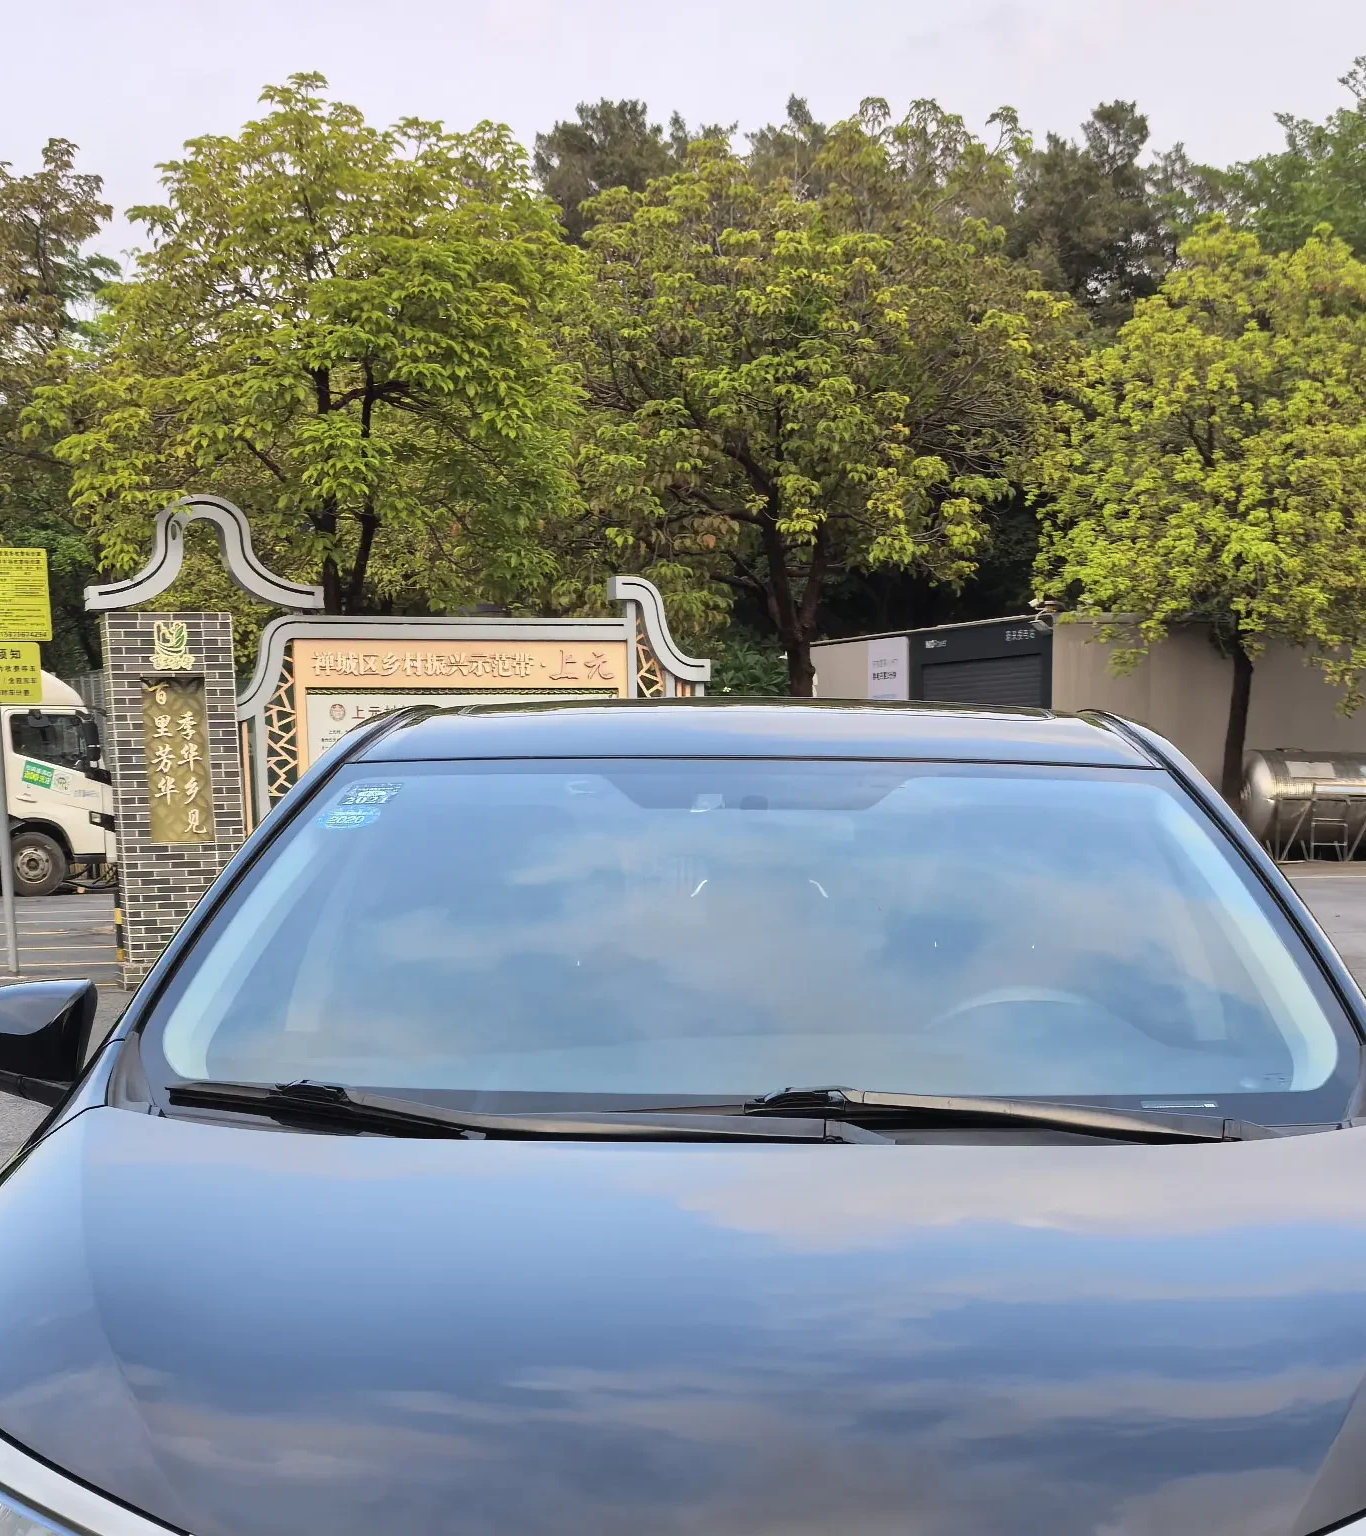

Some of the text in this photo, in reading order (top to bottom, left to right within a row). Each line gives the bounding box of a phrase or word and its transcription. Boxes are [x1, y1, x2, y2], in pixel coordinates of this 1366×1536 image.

[143, 681, 180, 805] 百里芳华
[176, 711, 208, 834] 季华乡见
